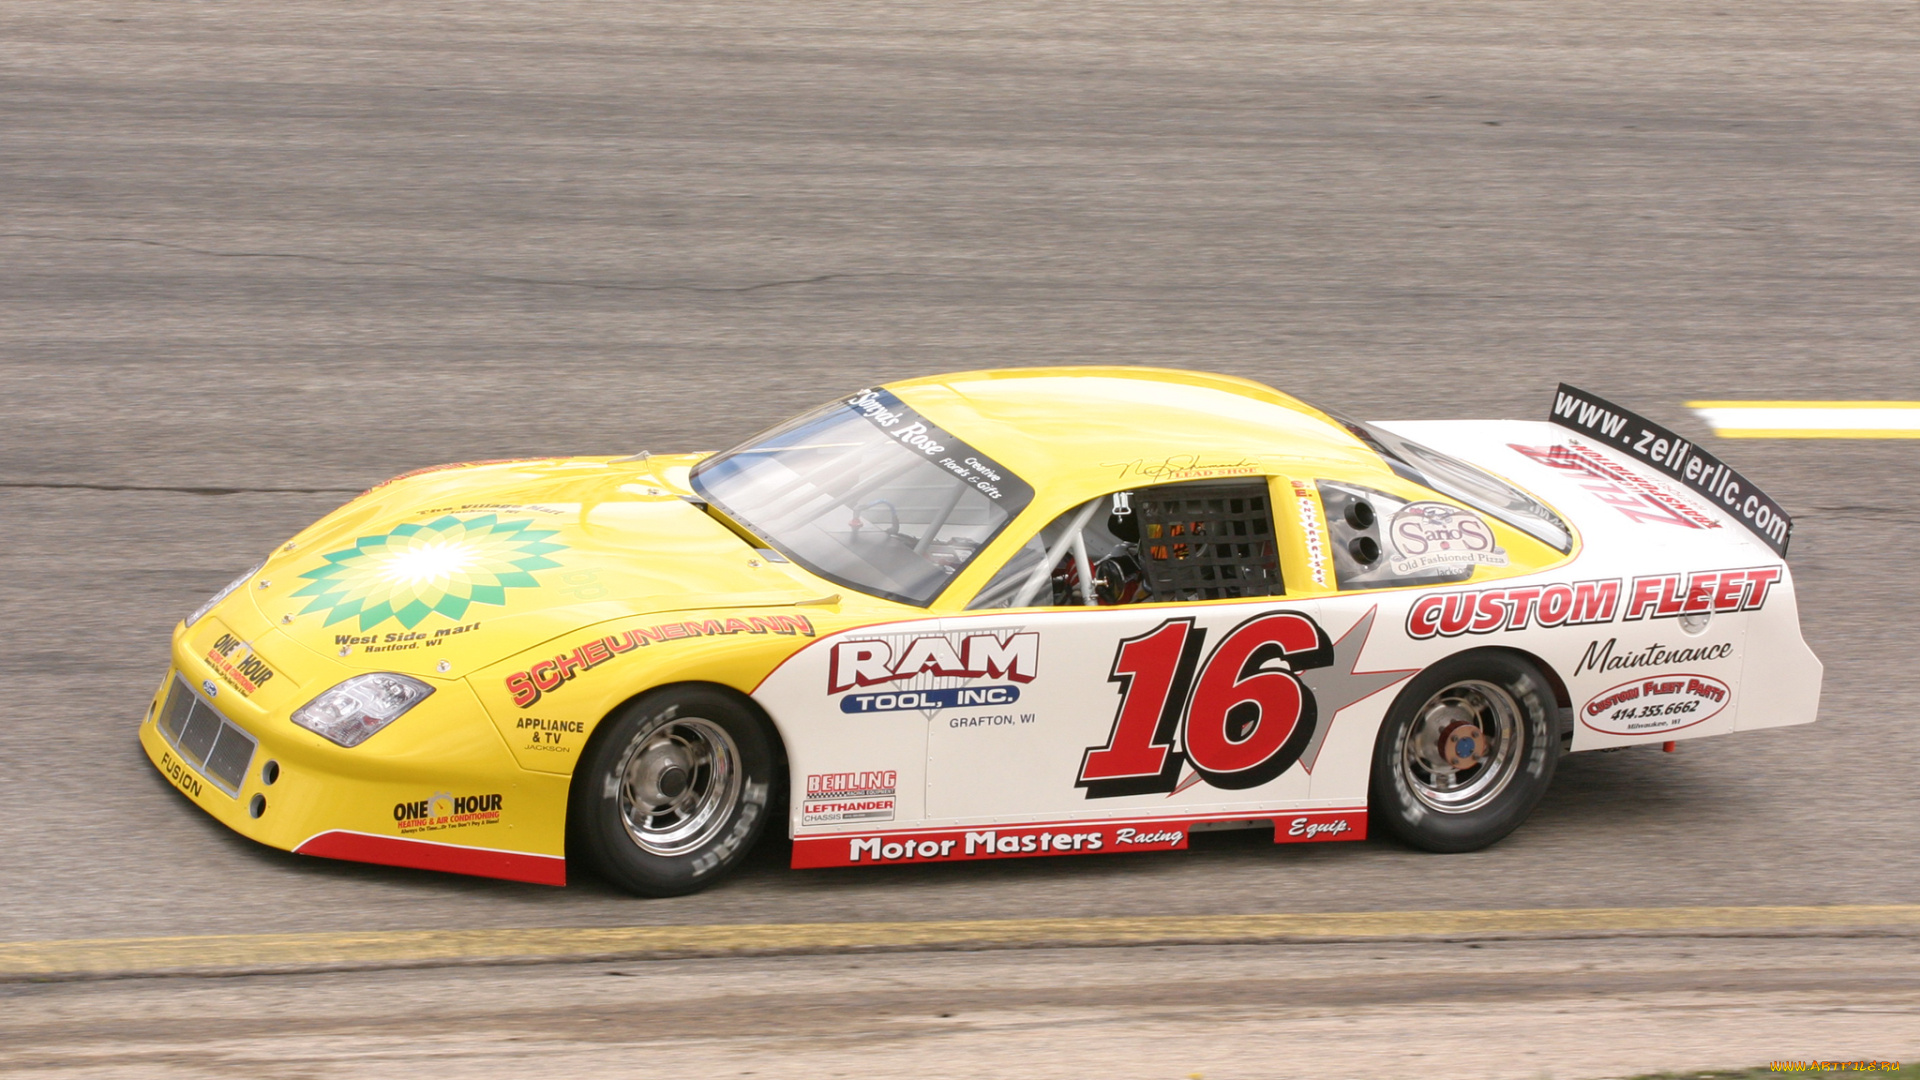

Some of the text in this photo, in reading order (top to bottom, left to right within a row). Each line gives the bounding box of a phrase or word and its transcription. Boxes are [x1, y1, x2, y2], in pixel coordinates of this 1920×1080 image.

[849, 391, 945, 456] Sonya's Rose
[939, 457, 1003, 500] Florals & Gifts
[964, 457, 1001, 482] Creative
[1218, 467, 1257, 476] SHOE
[1554, 392, 1788, 545] www.zellerllc.com
[1398, 554, 1505, 573] Old Fashioned Pizza
[1405, 565, 1783, 640] CUSTOM FLEET
[334, 622, 481, 645] West Side Mart
[425, 639, 443, 647] WI
[213, 633, 241, 657] ONE
[237, 654, 274, 688] HOUR
[505, 614, 816, 709] SCHEUNEMANN
[827, 632, 1040, 695] RAM
[1574, 638, 1734, 677] Maintenance
[856, 688, 1013, 711] TOOL, INC.
[1074, 610, 1334, 800] 16
[1587, 679, 1725, 716] CUSTOM FLEET PARTS
[949, 714, 1036, 728] GRAFTON, WI
[1611, 700, 1700, 721] 414.355.6662
[516, 717, 584, 733] APPLIANCE
[524, 744, 570, 752] JACKSON
[532, 731, 561, 744] & TV
[161, 752, 202, 797] FUSION
[807, 770, 897, 793] BEHLING
[393, 793, 502, 821] ONE HOUR
[804, 813, 841, 822] CHASSIS
[805, 800, 893, 813] LEFTHANDER
[397, 819, 427, 829] HEATING
[436, 816, 449, 825] AIR
[450, 811, 500, 823] CONDITIONING
[1288, 817, 1352, 839] Equip.
[849, 828, 1184, 861] Motor Masters Racing
